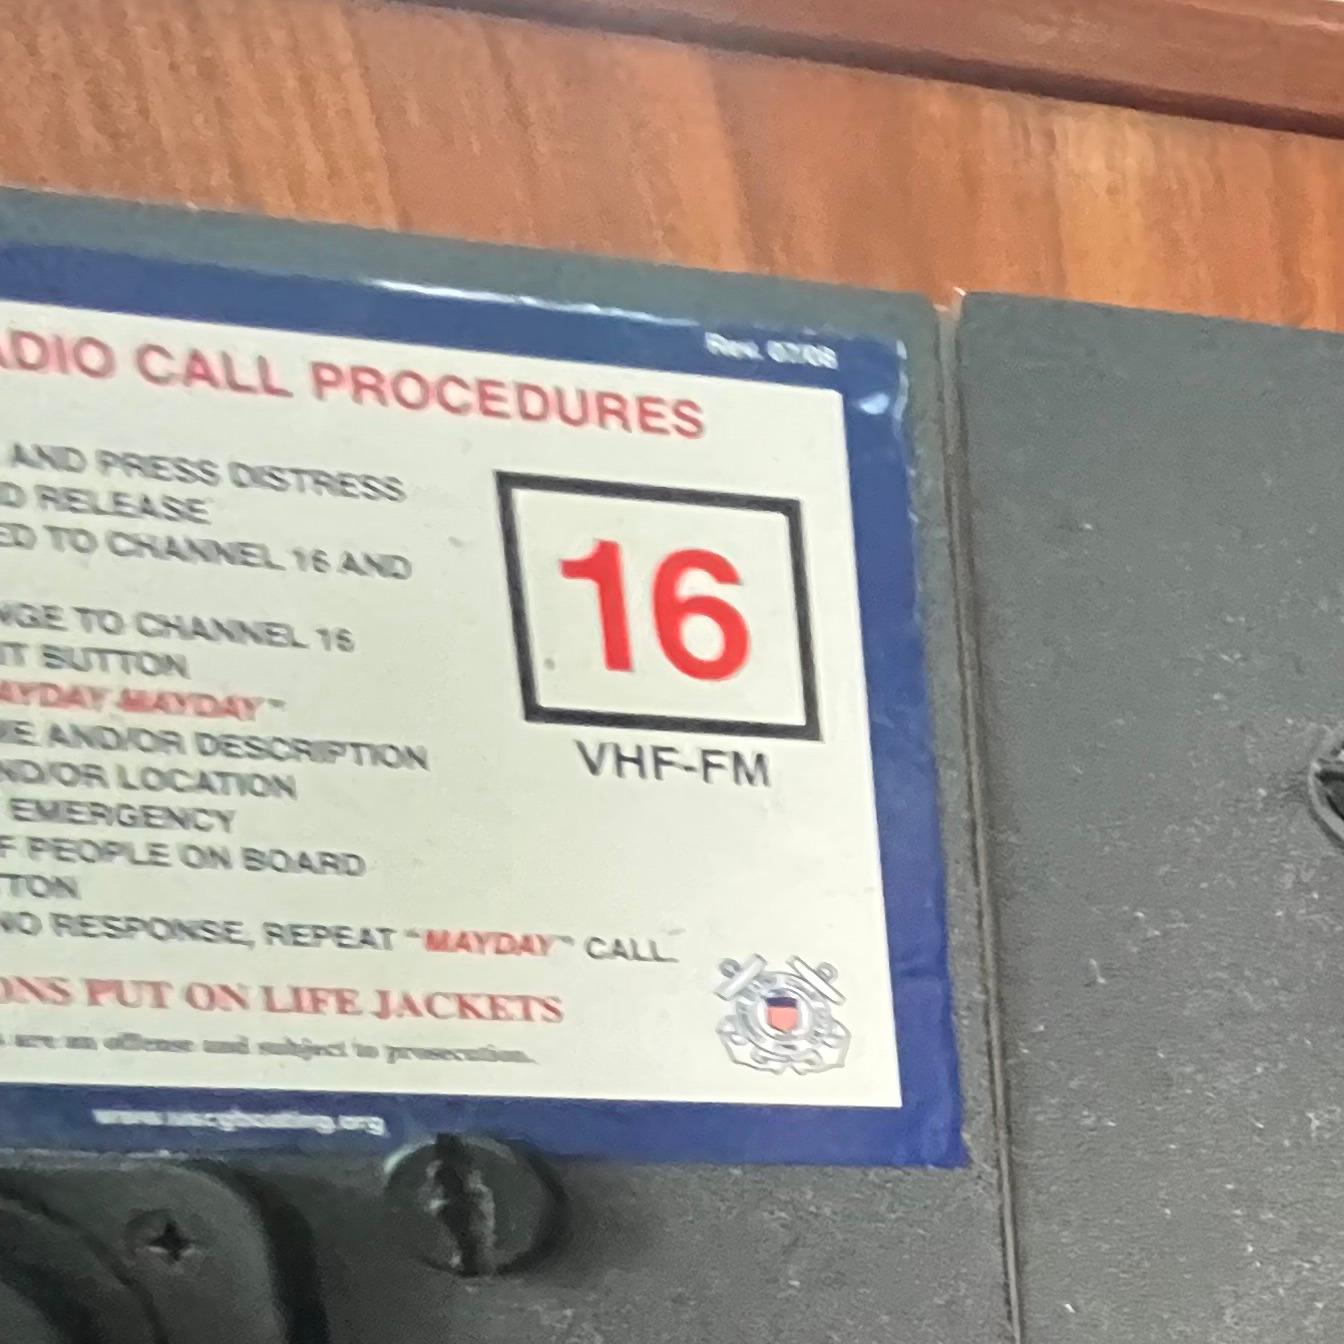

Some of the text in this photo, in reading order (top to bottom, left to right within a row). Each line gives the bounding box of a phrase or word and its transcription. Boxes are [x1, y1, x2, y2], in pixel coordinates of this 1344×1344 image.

[135, 342, 293, 398] CALL
[310, 360, 706, 441] PROCEDURES
[9, 442, 408, 503] AND PRESS DISTRESS
[35, 484, 212, 525] RELEASE
[43, 523, 97, 554] TO
[106, 530, 286, 571] CHANNEL
[293, 547, 330, 573] 16
[336, 549, 413, 580] AND
[73, 605, 126, 636] TO
[136, 610, 309, 650] CHANNEL
[315, 626, 356, 653] 16
[558, 537, 752, 683] 16
[41, 643, 191, 679] BUTTON
[195, 731, 430, 771] DESCRIPTION
[574, 739, 772, 788] VHF-FM
[116, 763, 298, 800] LOCATION
[11, 798, 237, 834] EMERGENCY
[26, 835, 171, 868] PEOPLE
[181, 844, 233, 870] ON
[240, 846, 368, 878] BOARD
[49, 912, 256, 950] RESPONSE,
[261, 922, 398, 951] REPEAT
[82, 977, 172, 1011] PUT
[184, 979, 251, 1013] ON
[259, 983, 365, 1016] LIFE
[374, 987, 565, 1024] JACKETS
